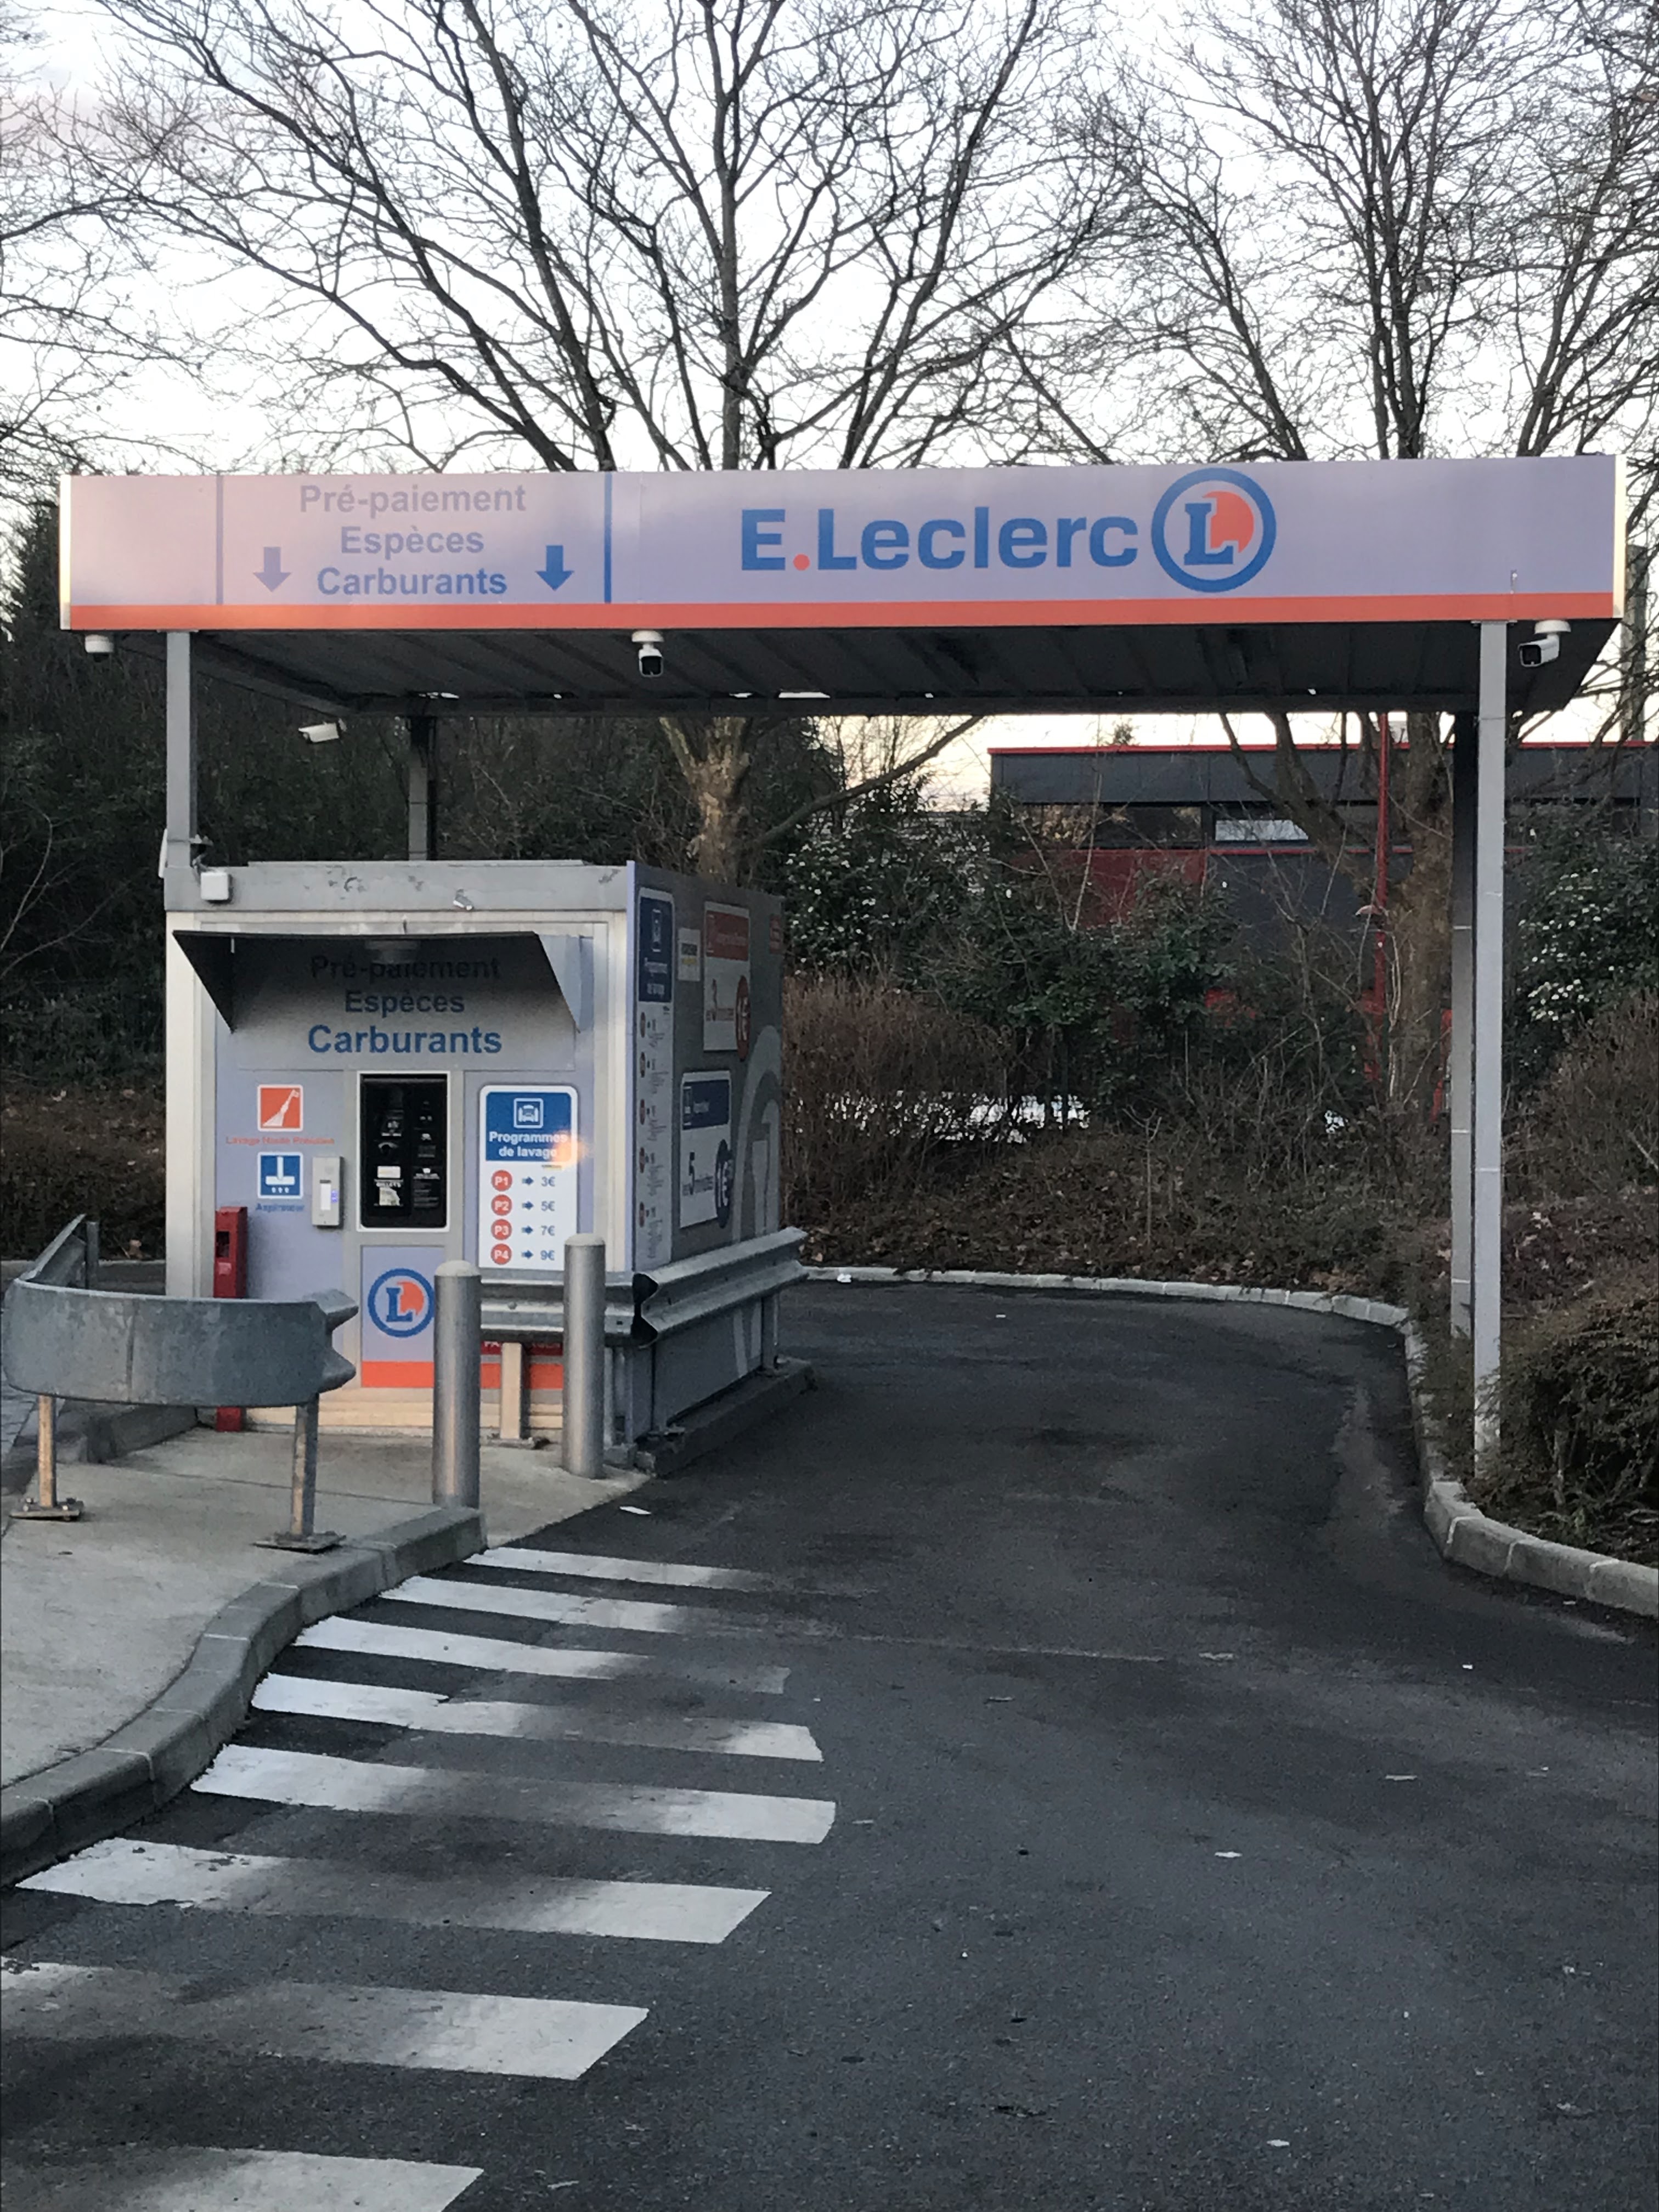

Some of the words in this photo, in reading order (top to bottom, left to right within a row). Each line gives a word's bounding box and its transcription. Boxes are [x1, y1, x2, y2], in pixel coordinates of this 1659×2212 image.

[300, 484, 526, 518] Pré-paiement
[341, 526, 484, 560] Espèces
[741, 506, 1139, 571] E.Leclerc
[317, 567, 507, 595] Carburants
[311, 954, 501, 984] Pré-paiement
[345, 989, 465, 1019] Espèces
[308, 1024, 502, 1054] Carburants
[489, 1131, 568, 1145] Programmes
[499, 1146, 515, 1157] de
[517, 1146, 557, 1160] lavage
[494, 1176, 509, 1186] P1
[541, 1176, 556, 1187] 3€
[494, 1201, 510, 1211] P2
[541, 1201, 555, 1211] 5€
[494, 1225, 510, 1235] P3
[541, 1226, 555, 1236] 7€
[494, 1250, 509, 1260] P4
[540, 1250, 555, 1261] 9€
